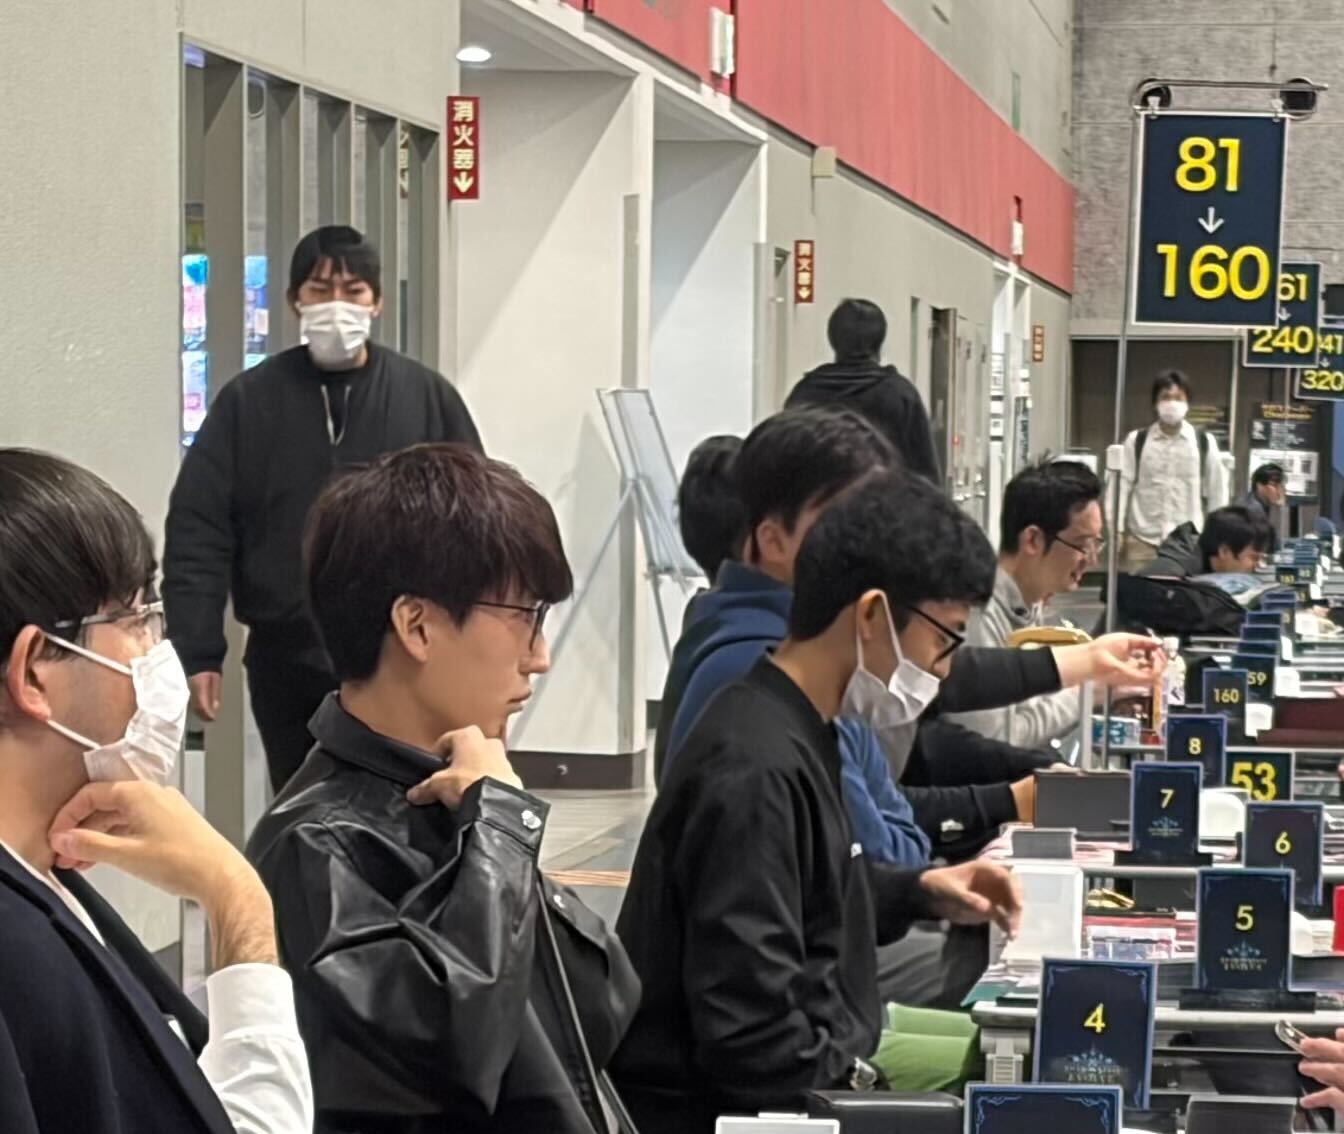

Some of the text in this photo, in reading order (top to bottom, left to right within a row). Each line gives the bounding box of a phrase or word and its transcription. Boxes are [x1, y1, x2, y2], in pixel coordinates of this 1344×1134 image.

[453, 101, 474, 169] 消火器
[1175, 137, 1241, 192] 81
[1157, 244, 1271, 301] 160
[1252, 325, 1315, 354] 240
[1318, 334, 1344, 354] 41
[1213, 688, 1239, 703] 160
[1188, 737, 1202, 755] 8
[1231, 761, 1277, 801] 53
[1160, 788, 1174, 808] 7
[1275, 832, 1292, 854] 6
[1235, 905, 1254, 931] 5
[1083, 1003, 1105, 1033] 4
